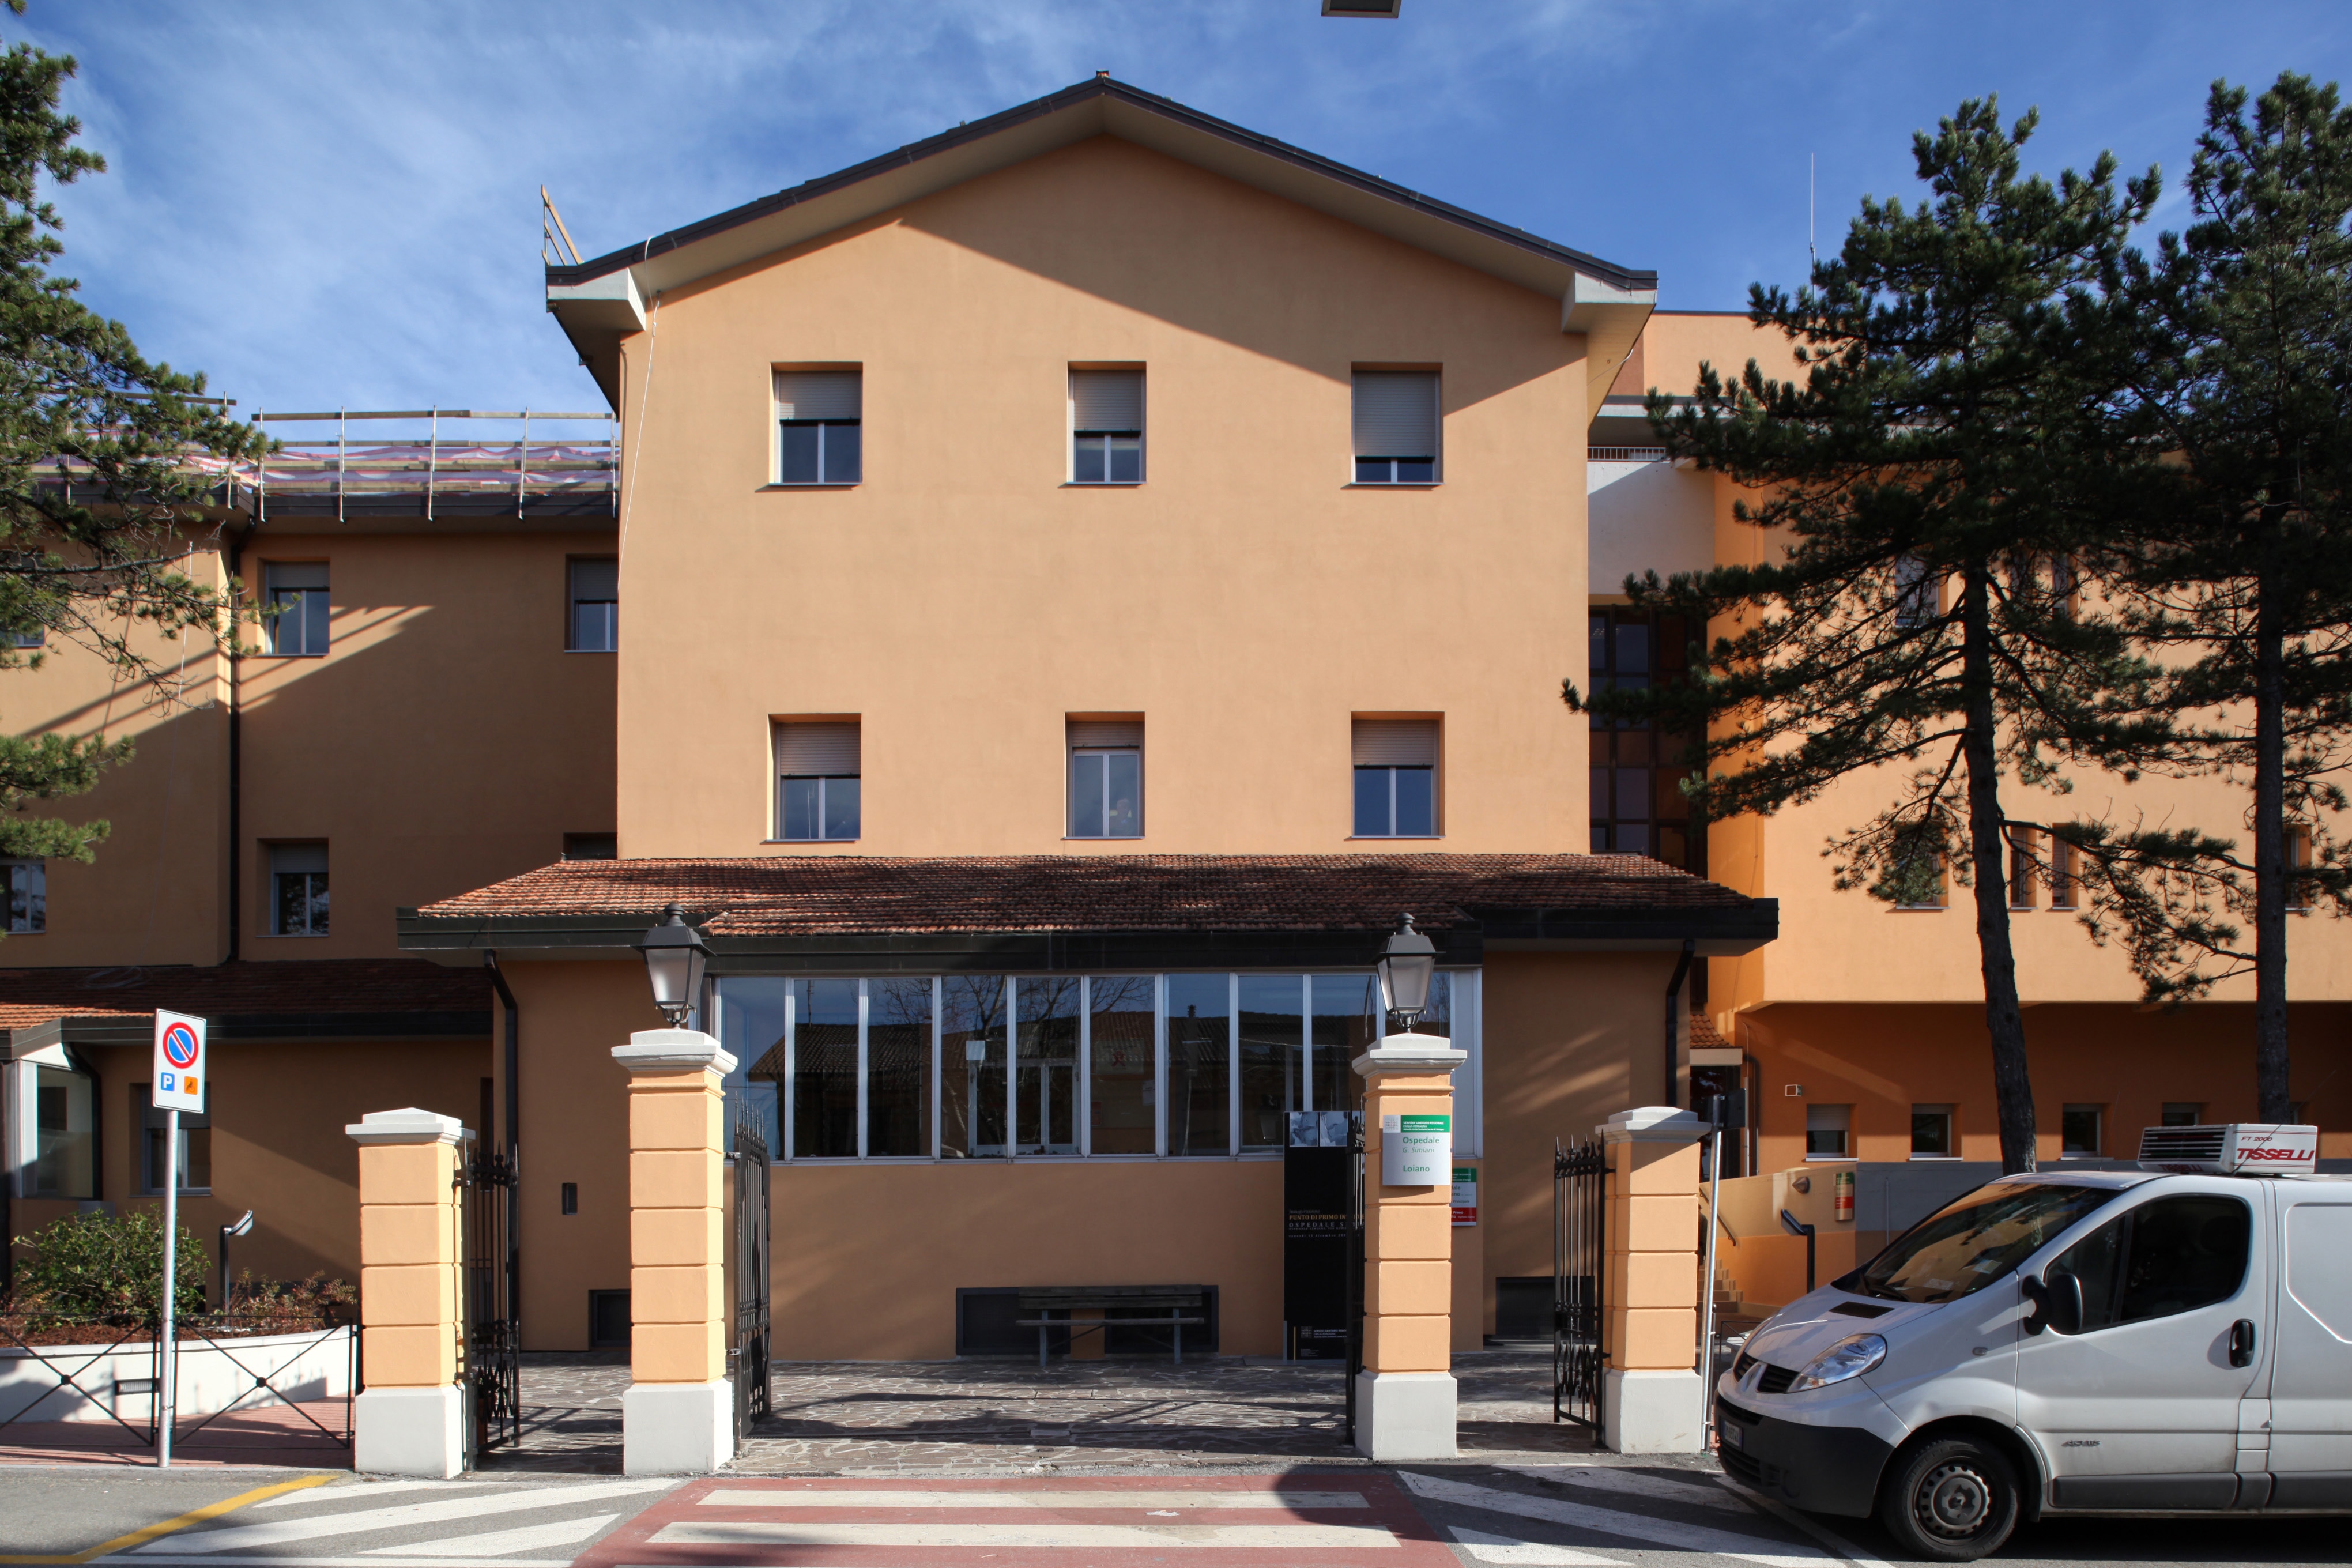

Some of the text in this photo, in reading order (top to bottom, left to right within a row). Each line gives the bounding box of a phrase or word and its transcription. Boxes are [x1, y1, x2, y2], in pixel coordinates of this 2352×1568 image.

[163, 1075, 173, 1088] P
[1402, 1136, 1440, 1145] Ospedale
[2237, 1148, 2315, 1161] TISSELLI
